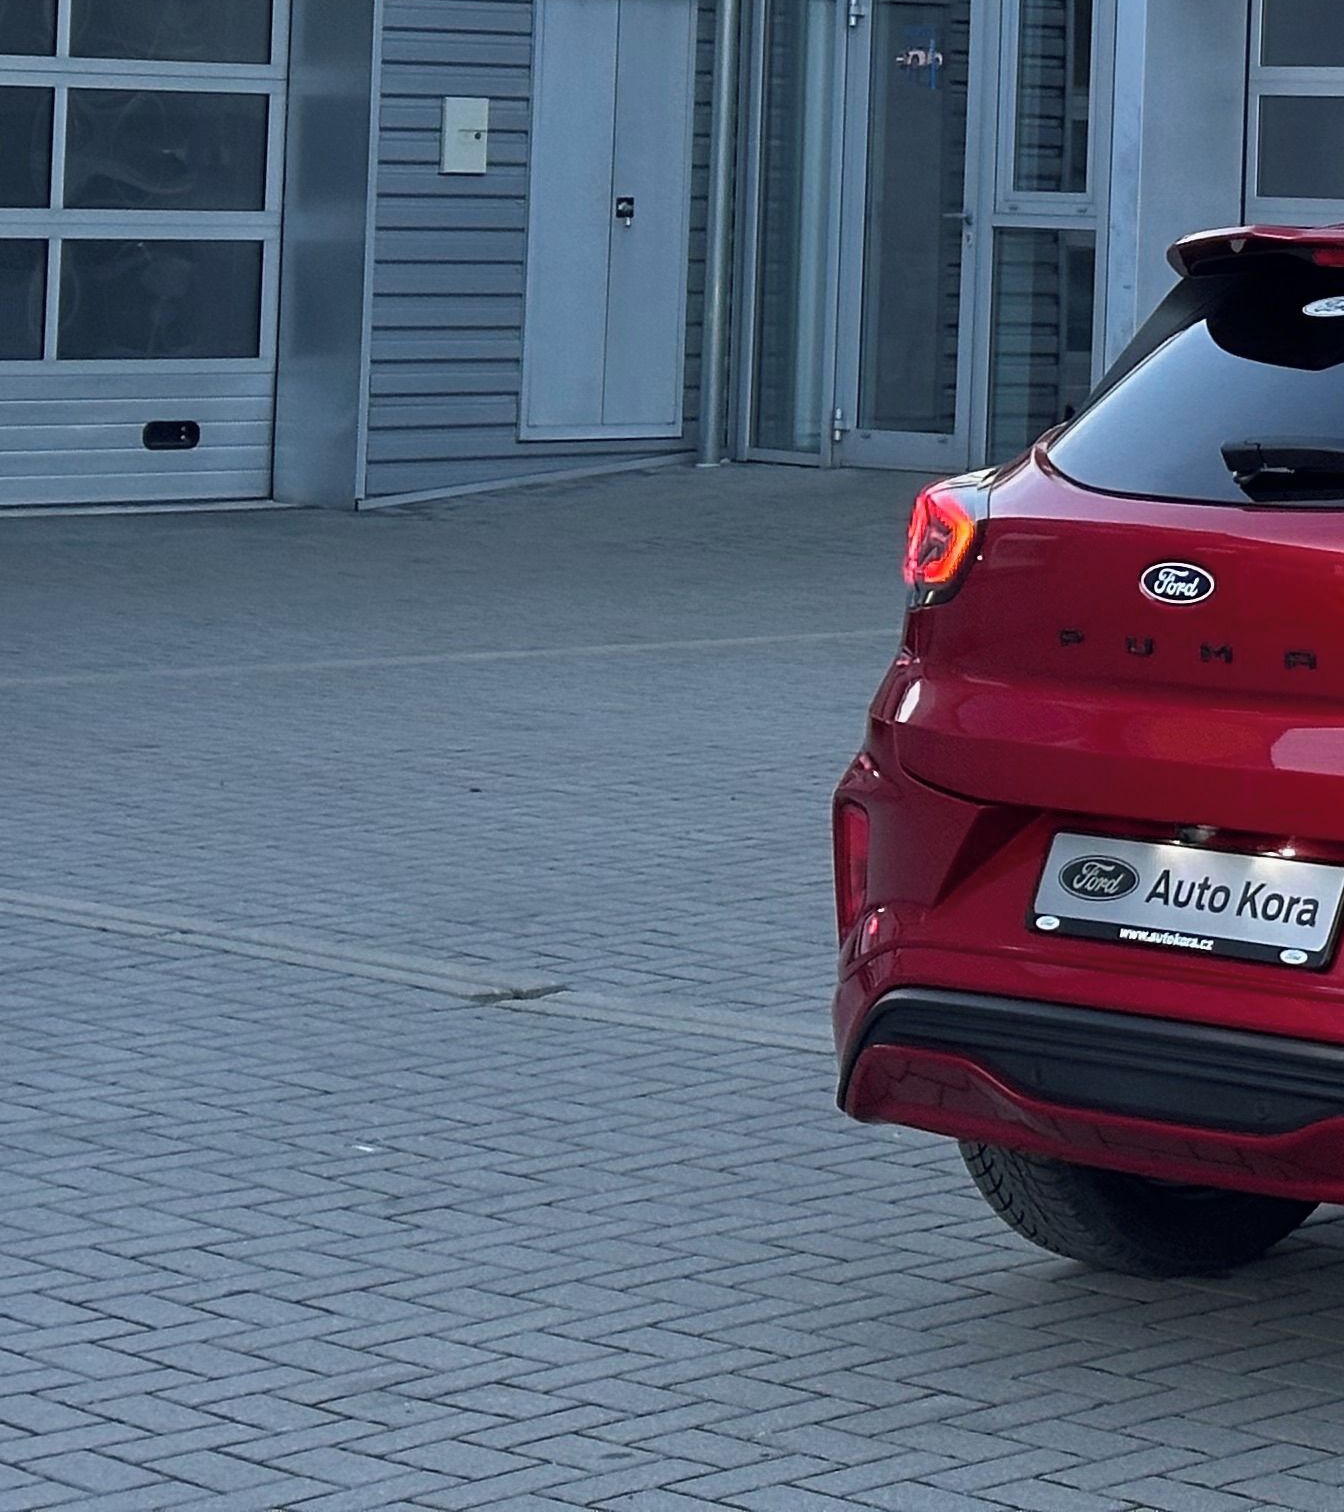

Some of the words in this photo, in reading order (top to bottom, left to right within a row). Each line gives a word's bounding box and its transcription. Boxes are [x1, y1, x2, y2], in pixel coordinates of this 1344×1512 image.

[1153, 568, 1199, 598] Ford
[1059, 628, 1318, 670] PUMA
[1072, 861, 1125, 895] Ford
[1145, 869, 1231, 914] Auto
[1236, 881, 1319, 927] Kora
